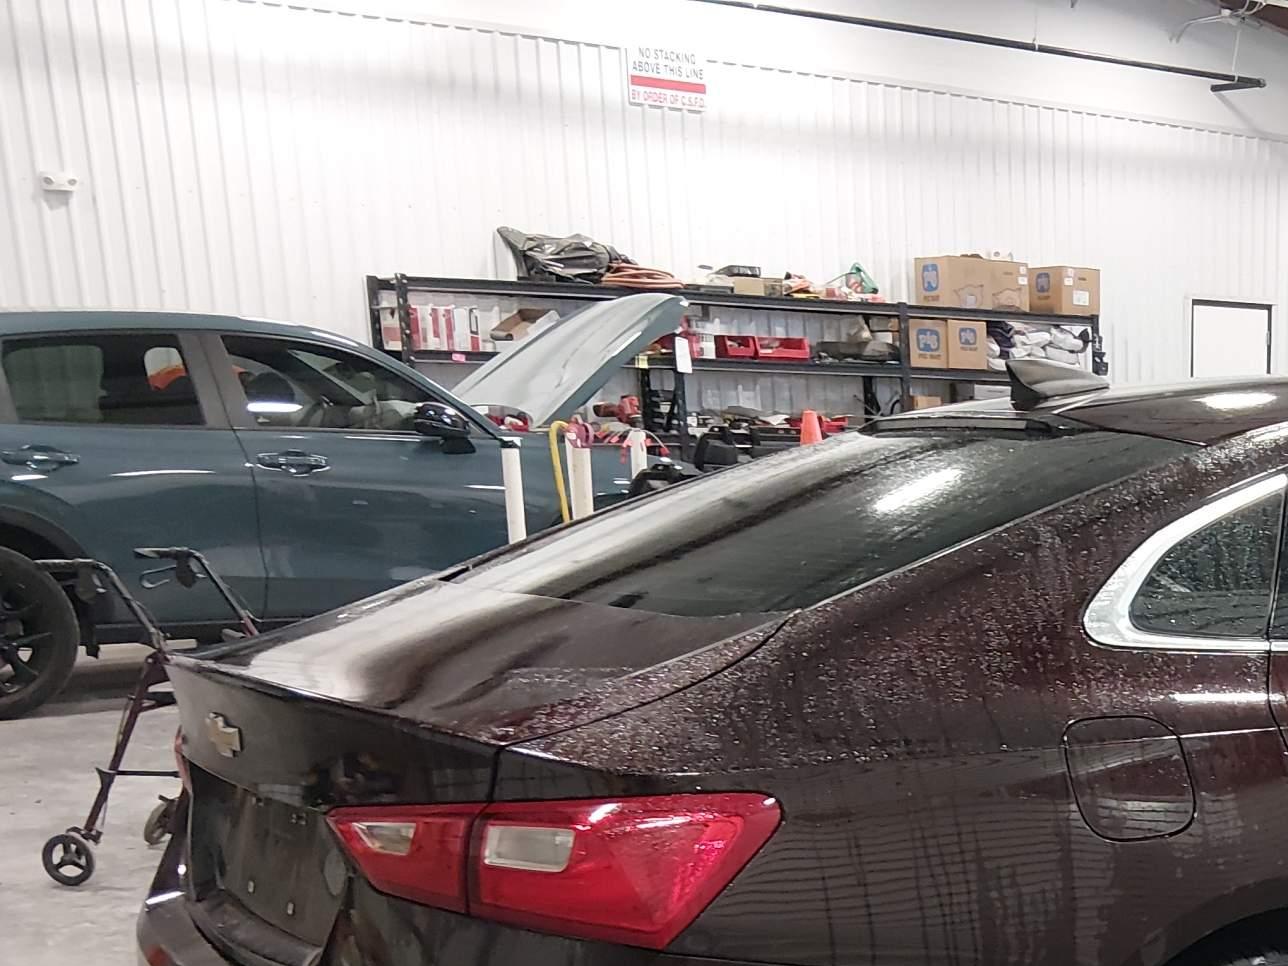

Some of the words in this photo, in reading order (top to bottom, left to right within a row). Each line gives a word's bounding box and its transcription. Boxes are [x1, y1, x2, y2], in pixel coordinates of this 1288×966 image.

[638, 47, 651, 59] NO
[654, 48, 696, 65] STACKING
[632, 60, 661, 74] ABOVE
[663, 64, 683, 78] THIS
[685, 68, 704, 80] LINE
